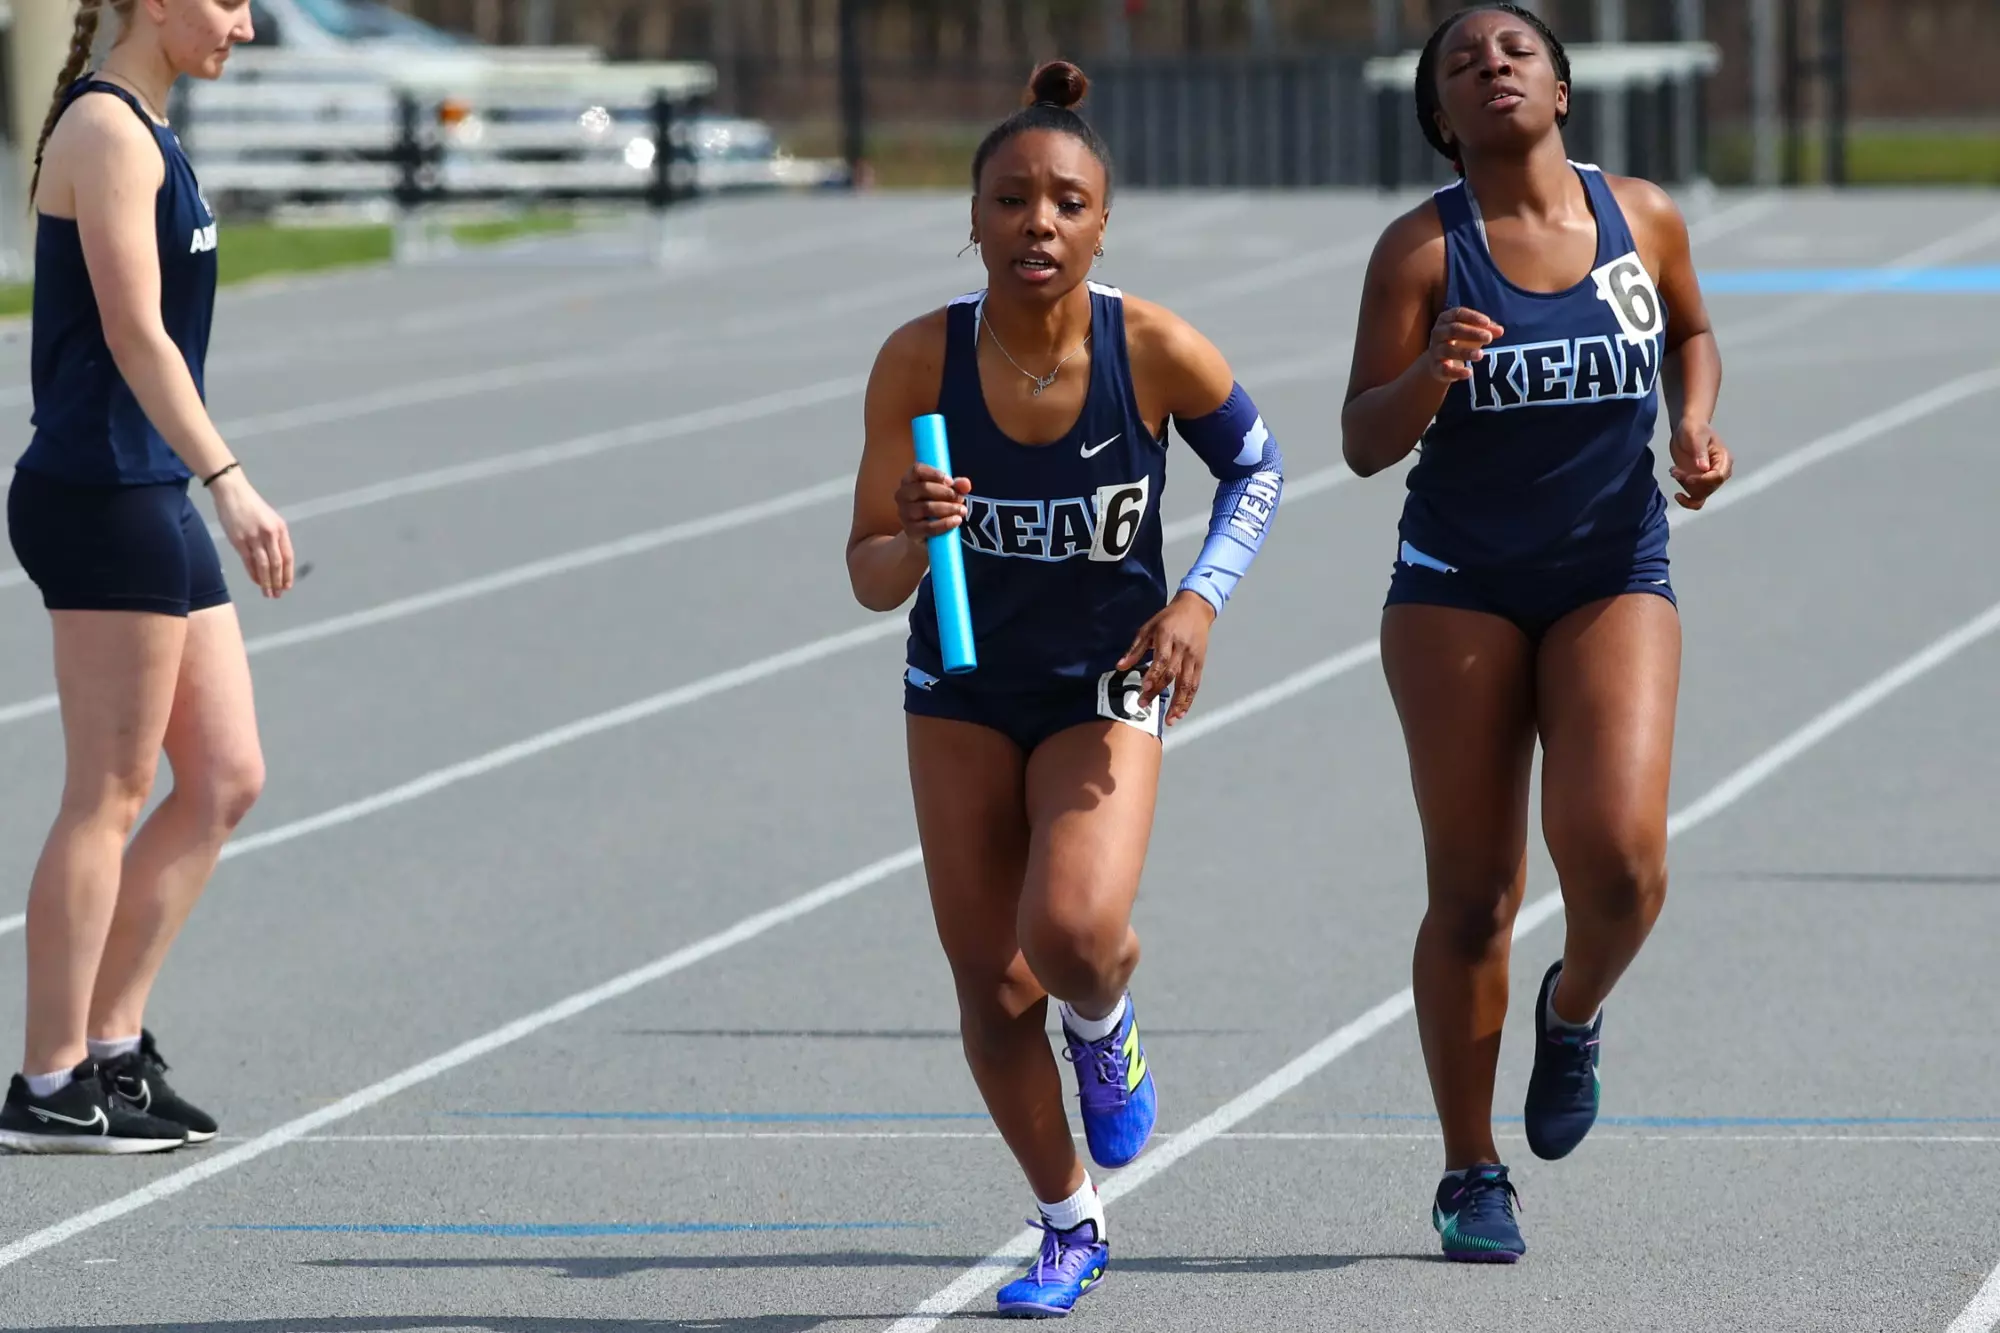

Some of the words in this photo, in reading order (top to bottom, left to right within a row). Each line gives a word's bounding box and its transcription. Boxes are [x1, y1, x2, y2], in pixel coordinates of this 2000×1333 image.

[1608, 261, 1656, 333] 6
[1468, 332, 1660, 411] KEAN
[961, 494, 1098, 562] KEA
[1102, 487, 1143, 556] 6
[1229, 470, 1282, 541] KEAN
